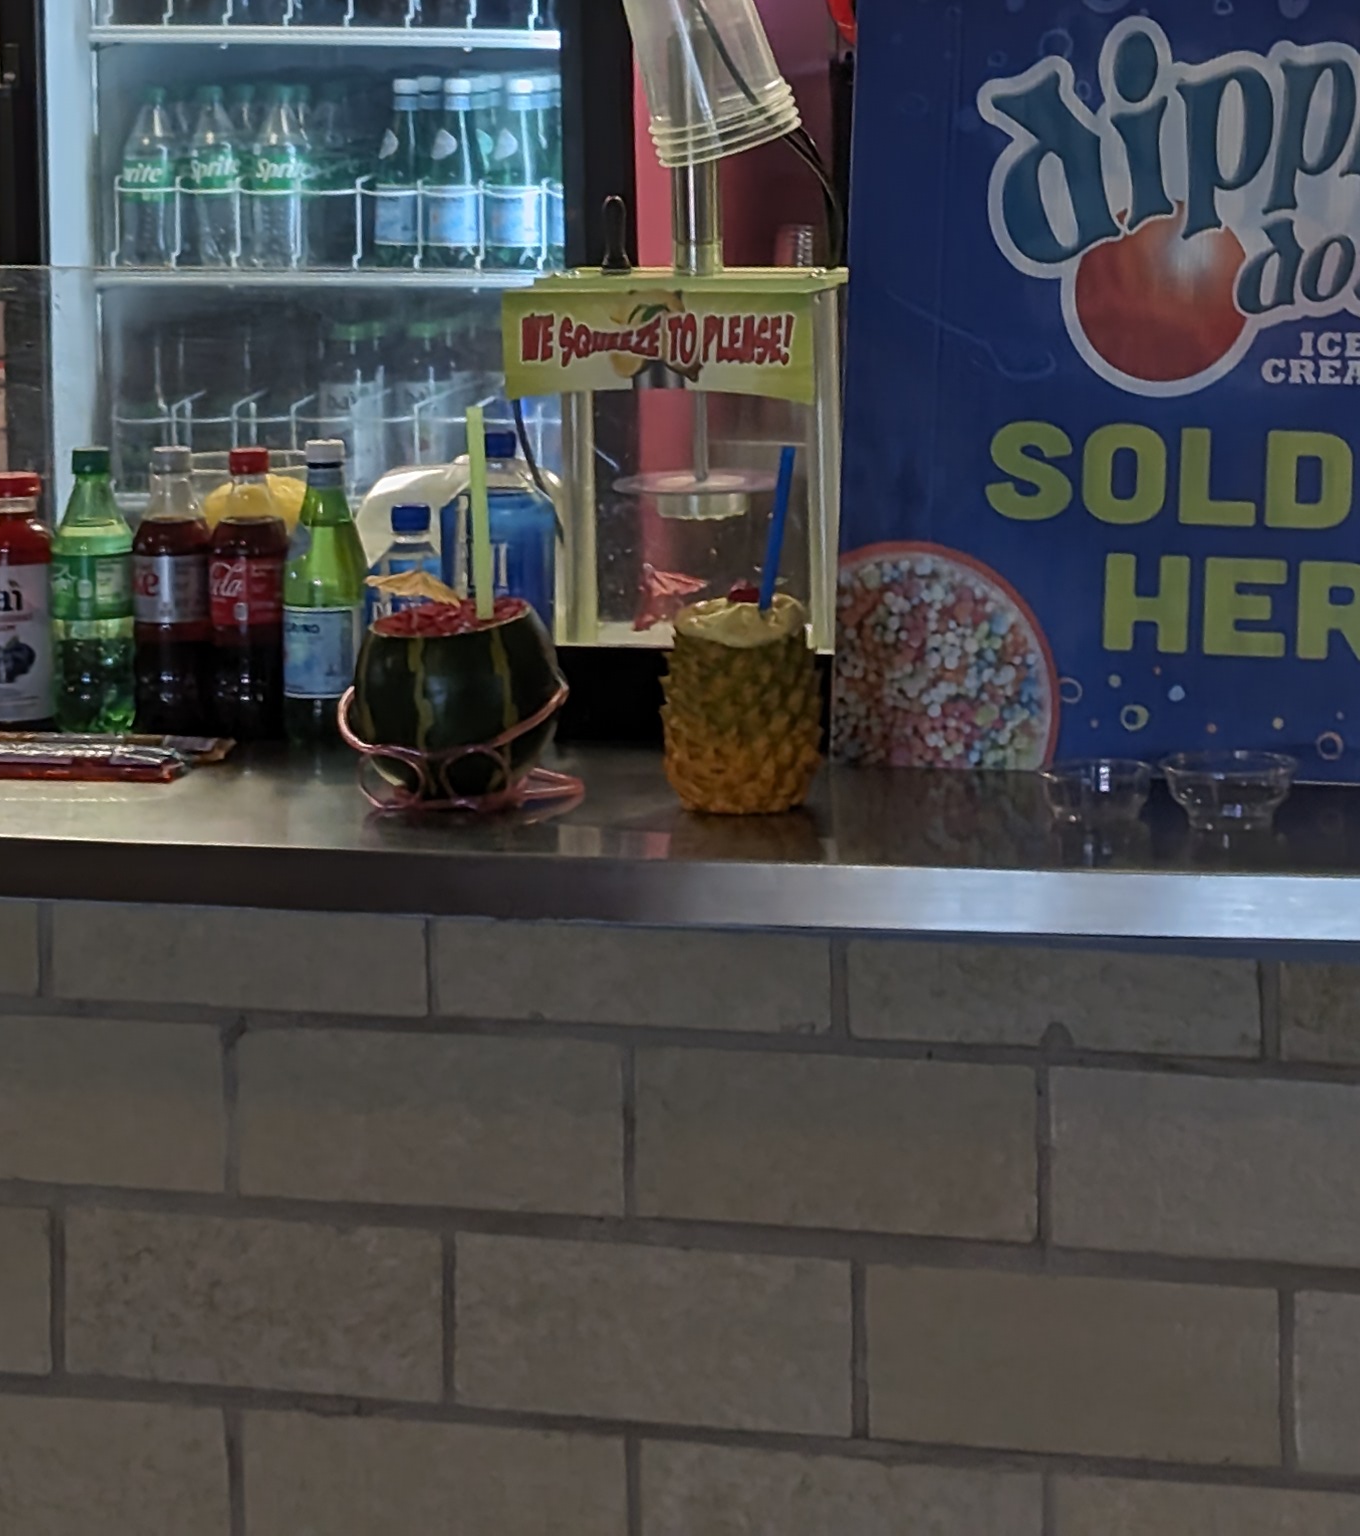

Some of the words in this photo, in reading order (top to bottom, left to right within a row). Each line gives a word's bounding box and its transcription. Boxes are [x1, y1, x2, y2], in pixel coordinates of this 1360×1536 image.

[521, 312, 555, 364] WE
[559, 316, 660, 367] SQUEEZE
[669, 312, 698, 365] TO
[701, 312, 795, 367] PLEASE!
[985, 421, 1354, 529] SOLD
